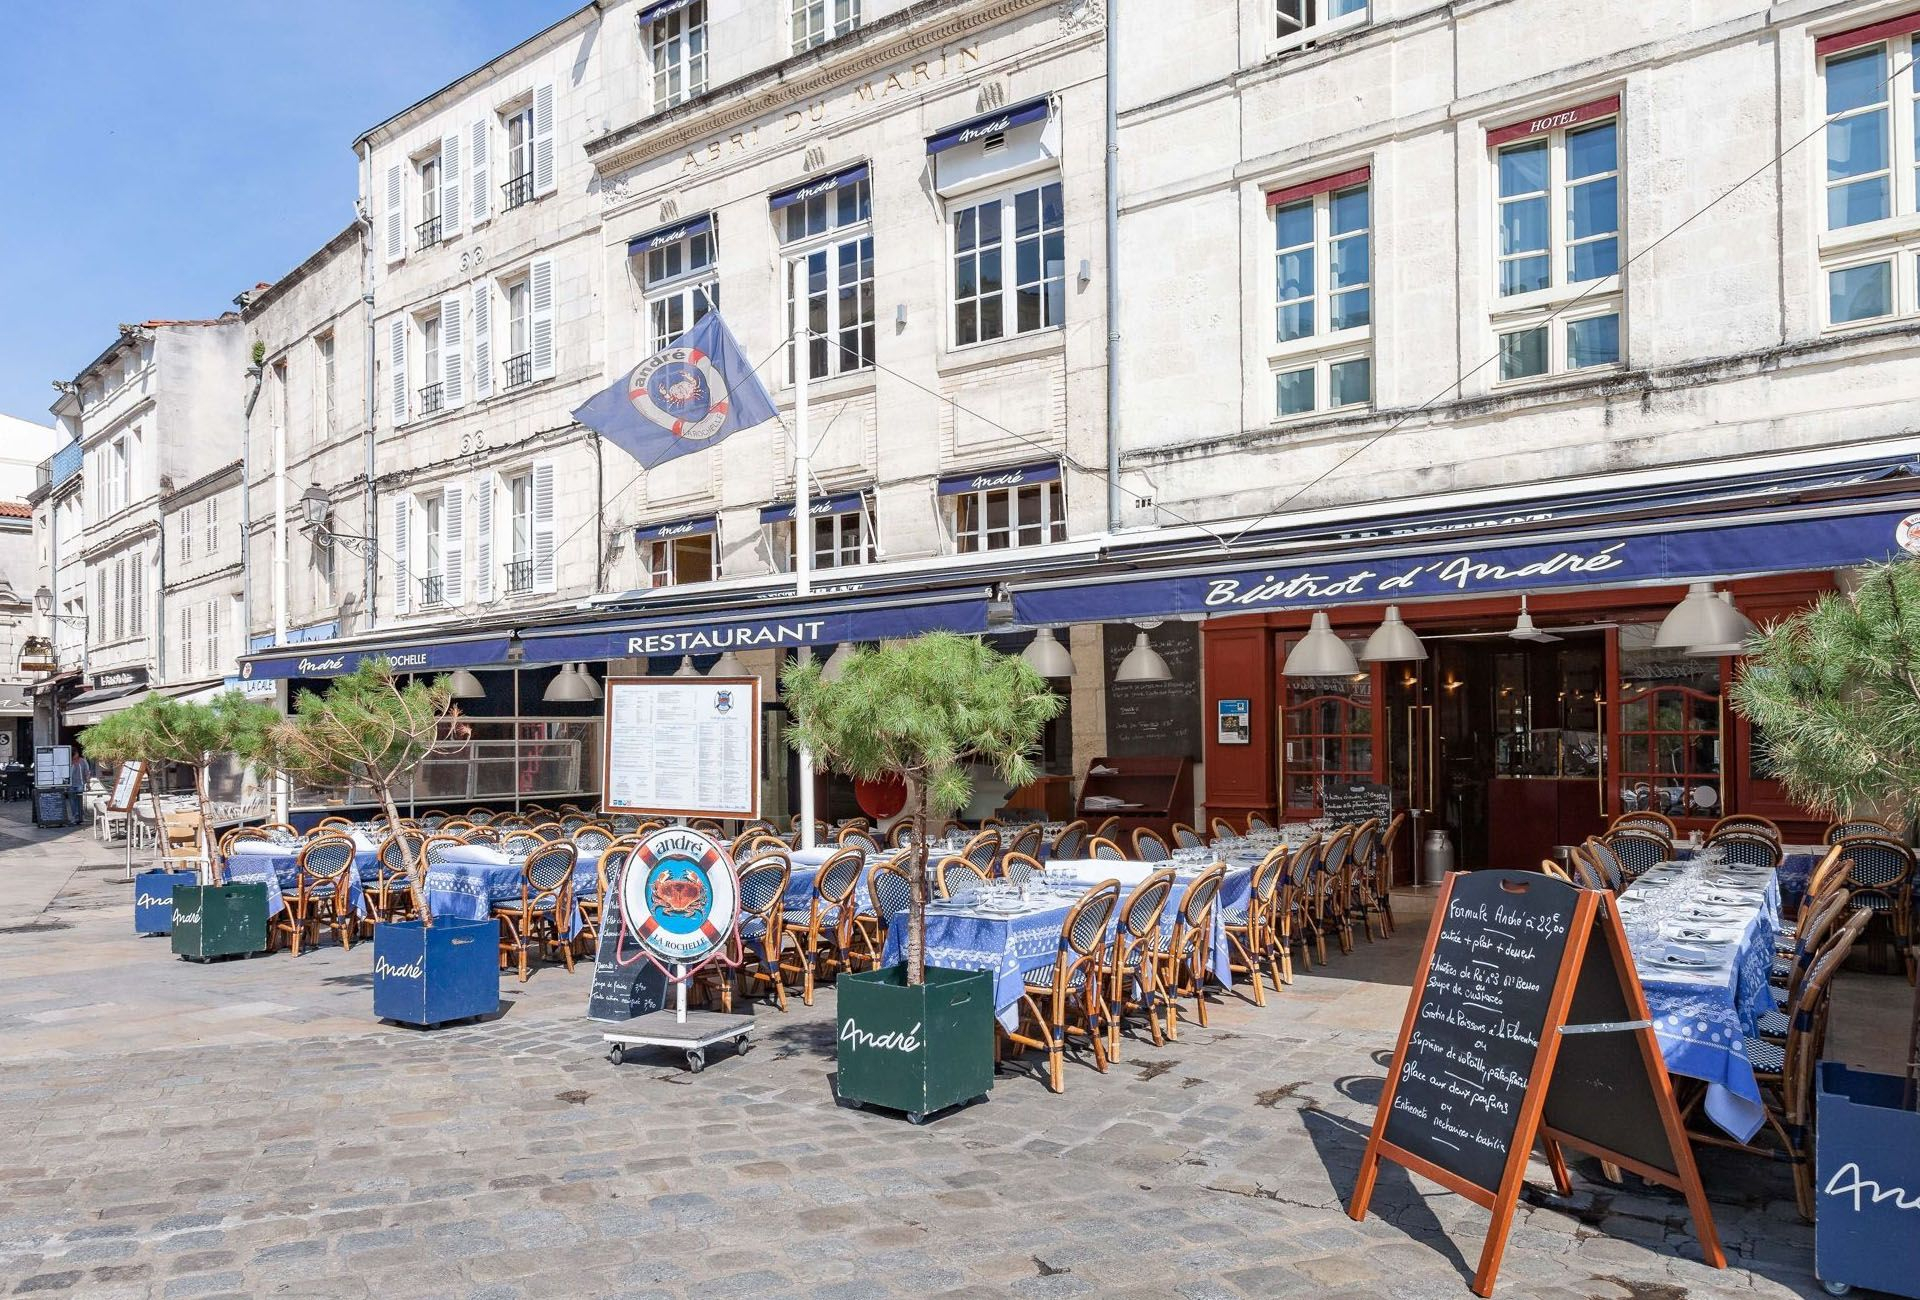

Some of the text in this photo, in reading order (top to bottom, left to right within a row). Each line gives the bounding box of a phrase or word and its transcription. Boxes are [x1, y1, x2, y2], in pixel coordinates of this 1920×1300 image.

[681, 41, 980, 172] ABRI DU MARIN
[959, 116, 1011, 142] André
[1530, 111, 1578, 133] HOTEL
[796, 177, 840, 200] André
[650, 226, 687, 248] André
[635, 349, 686, 388] andré
[971, 470, 1025, 490] André
[788, 501, 833, 518] Adré
[658, 521, 695, 537] André
[1204, 542, 1627, 606] Bistrot d'André
[628, 621, 825, 654] RESTAURANT
[298, 656, 345, 674] André
[655, 835, 703, 855] andré
[172, 905, 202, 926] André
[1450, 898, 1488, 922] Formule
[1495, 905, 1526, 927] André
[653, 933, 706, 951] LA ROCHELLE
[1471, 935, 1494, 953] plat
[1505, 942, 1536, 960] dessert
[375, 955, 425, 979] André
[1427, 976, 1450, 995] Soupe
[1475, 983, 1486, 991] ou
[1421, 1002, 1445, 1021] Gratin
[1445, 1008, 1456, 1025] de
[1457, 1010, 1486, 1034] Poissons
[1496, 1018, 1505, 1038] la
[840, 1018, 922, 1052] André
[1446, 1047, 1457, 1060] de
[1430, 1075, 1446, 1089] aux
[1448, 1081, 1471, 1099] deux
[1470, 1092, 1509, 1114] parfums
